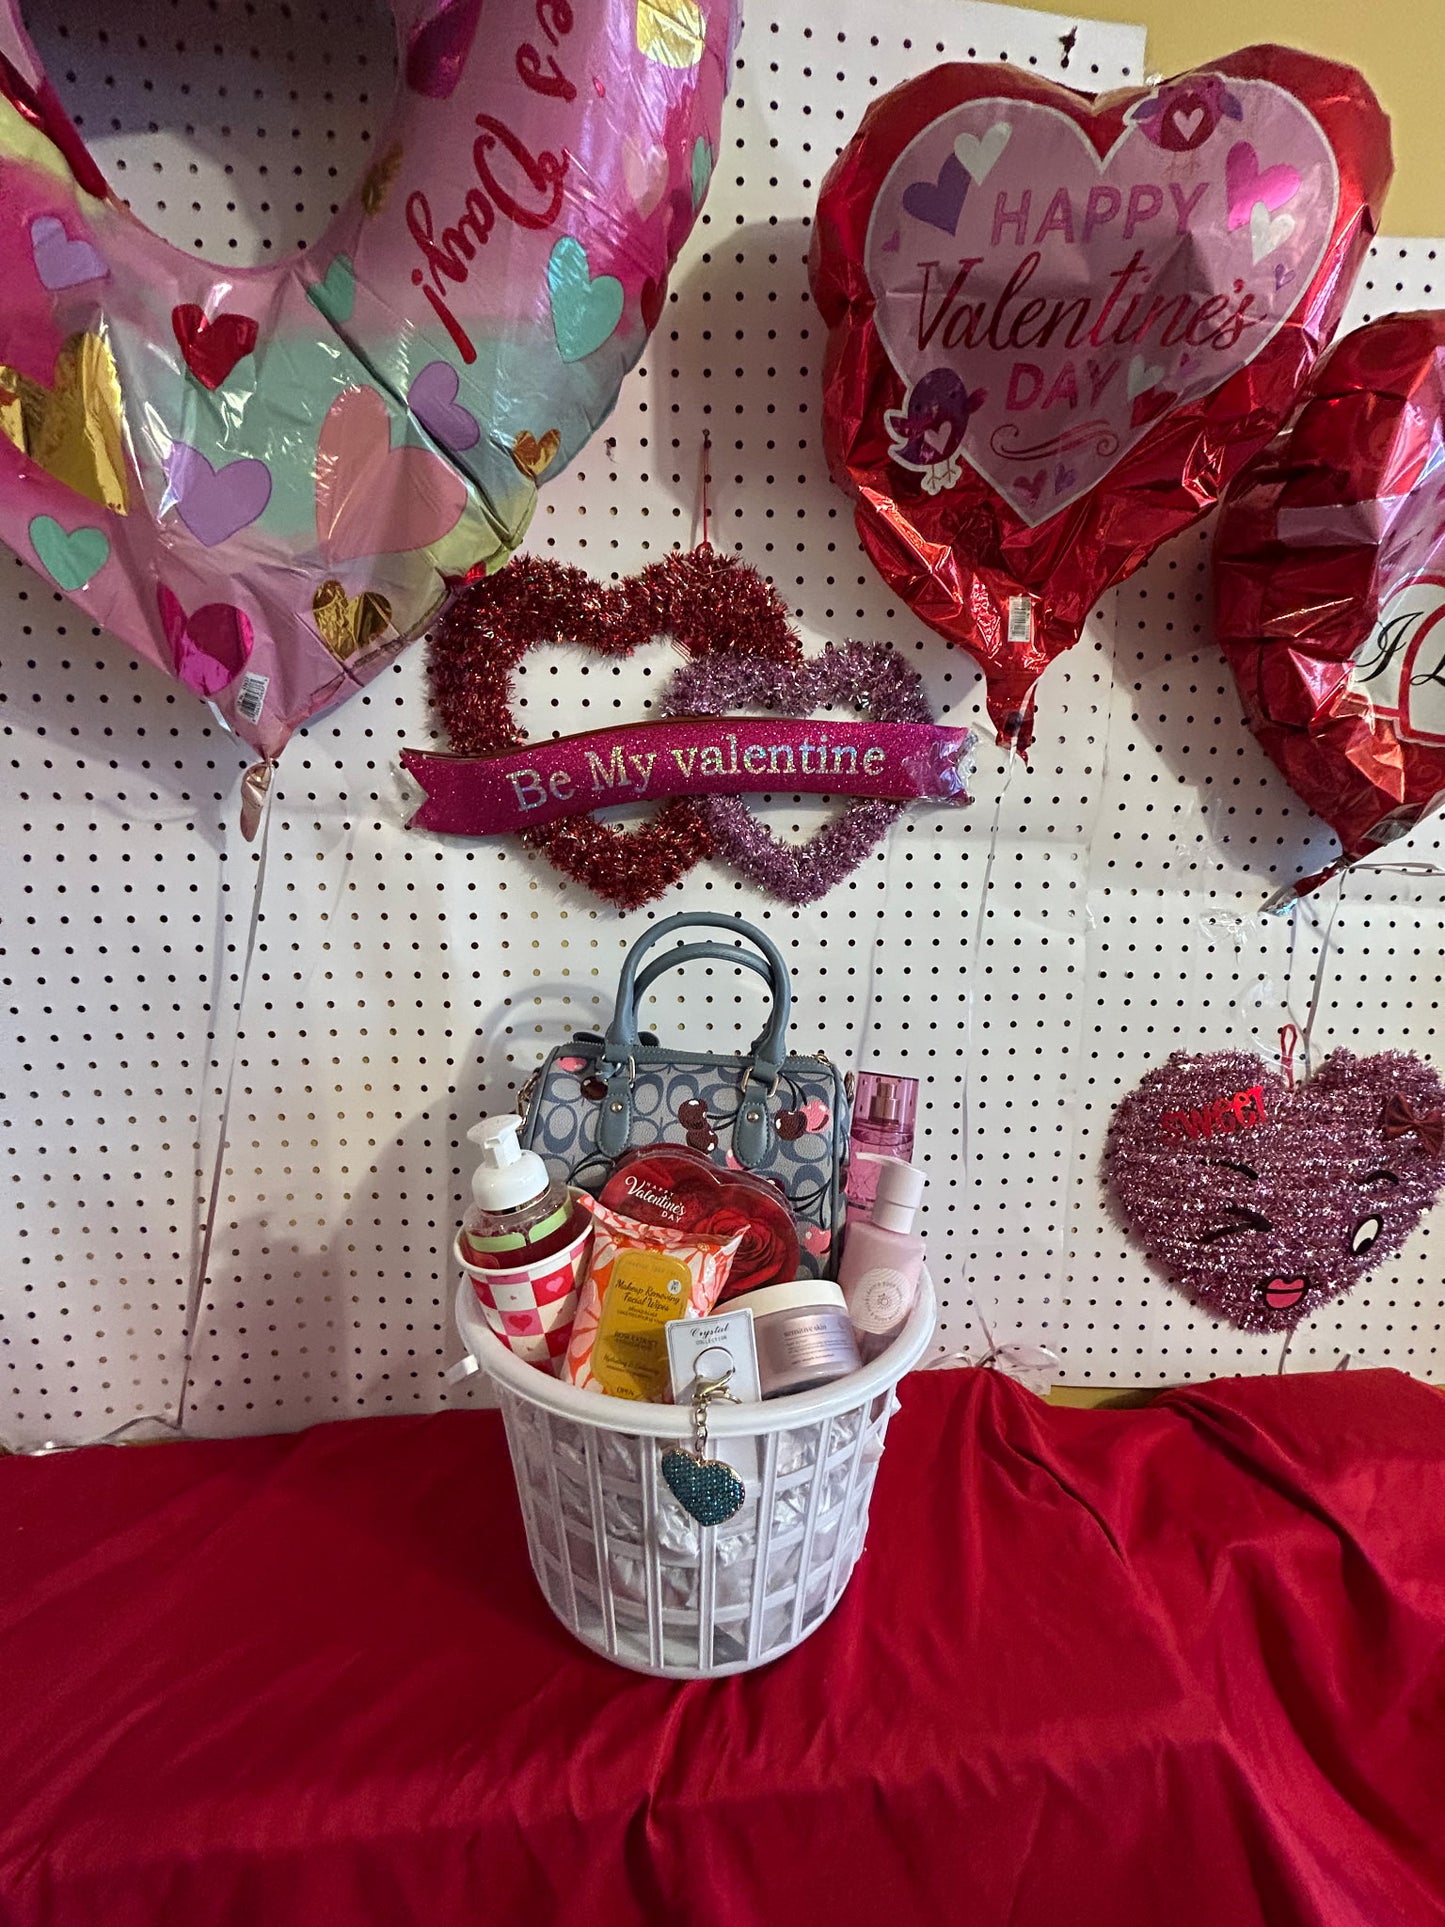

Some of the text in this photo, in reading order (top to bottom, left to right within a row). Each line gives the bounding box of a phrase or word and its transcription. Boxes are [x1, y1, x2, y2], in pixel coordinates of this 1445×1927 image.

[990, 181, 1210, 246] HAPPY
[405, 112, 571, 365] Day!
[916, 250, 1268, 351] Valentine's
[1005, 358, 1121, 412] DAY
[505, 733, 887, 813] Be My valentine
[624, 1175, 687, 1216] Valentine's
[661, 1210, 682, 1223] DAY
[615, 1278, 681, 1305] Makeup Removing
[623, 1292, 670, 1312] Facial Wipes
[689, 1322, 730, 1339] Crystal
